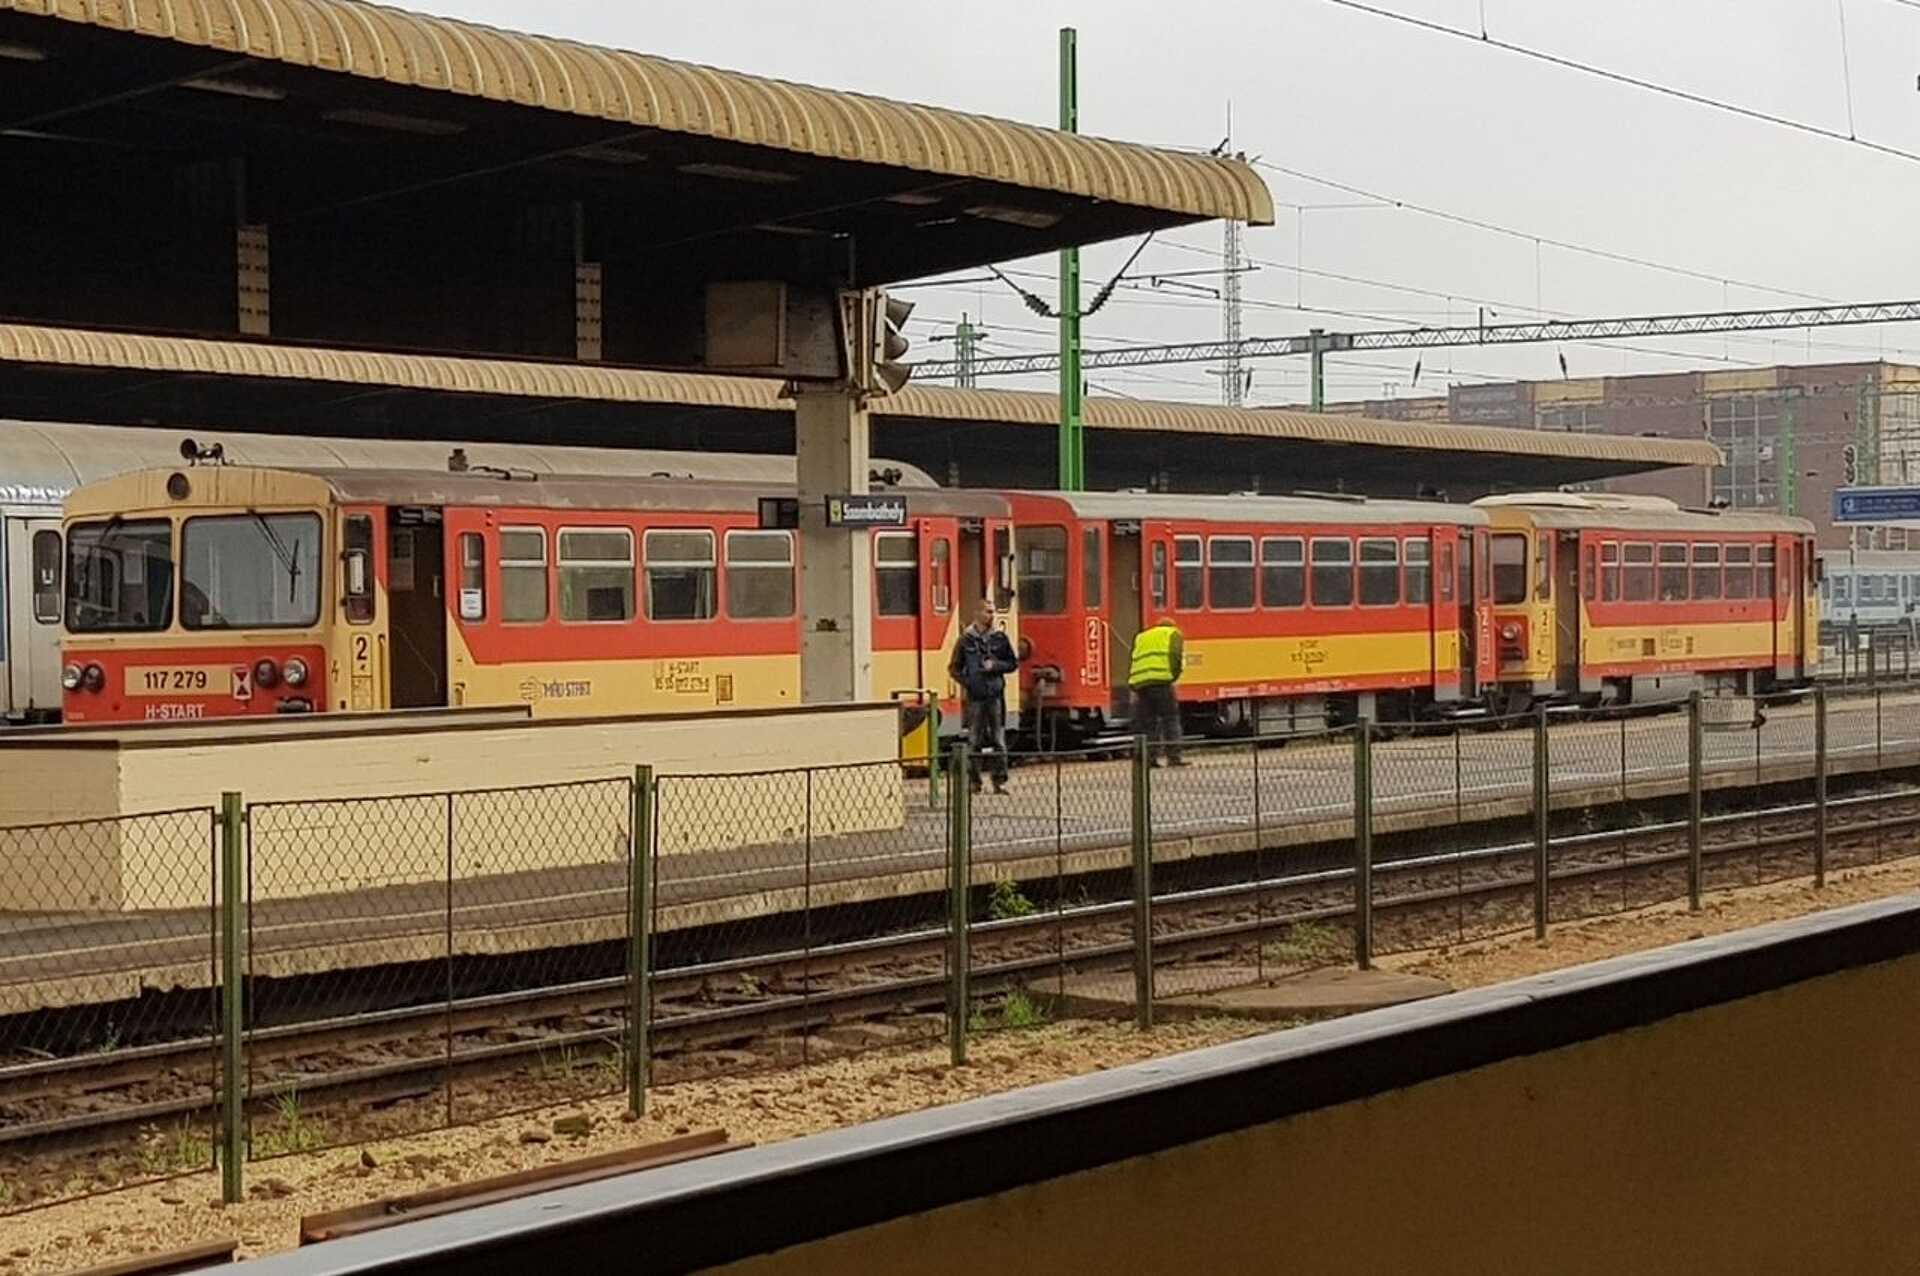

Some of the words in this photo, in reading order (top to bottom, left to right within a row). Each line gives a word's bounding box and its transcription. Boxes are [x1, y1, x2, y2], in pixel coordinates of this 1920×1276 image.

[1088, 620, 1098, 639] 2
[355, 637, 368, 660] 2
[144, 671, 168, 689] 117
[173, 670, 207, 689] 279
[145, 703, 206, 719] H-START
